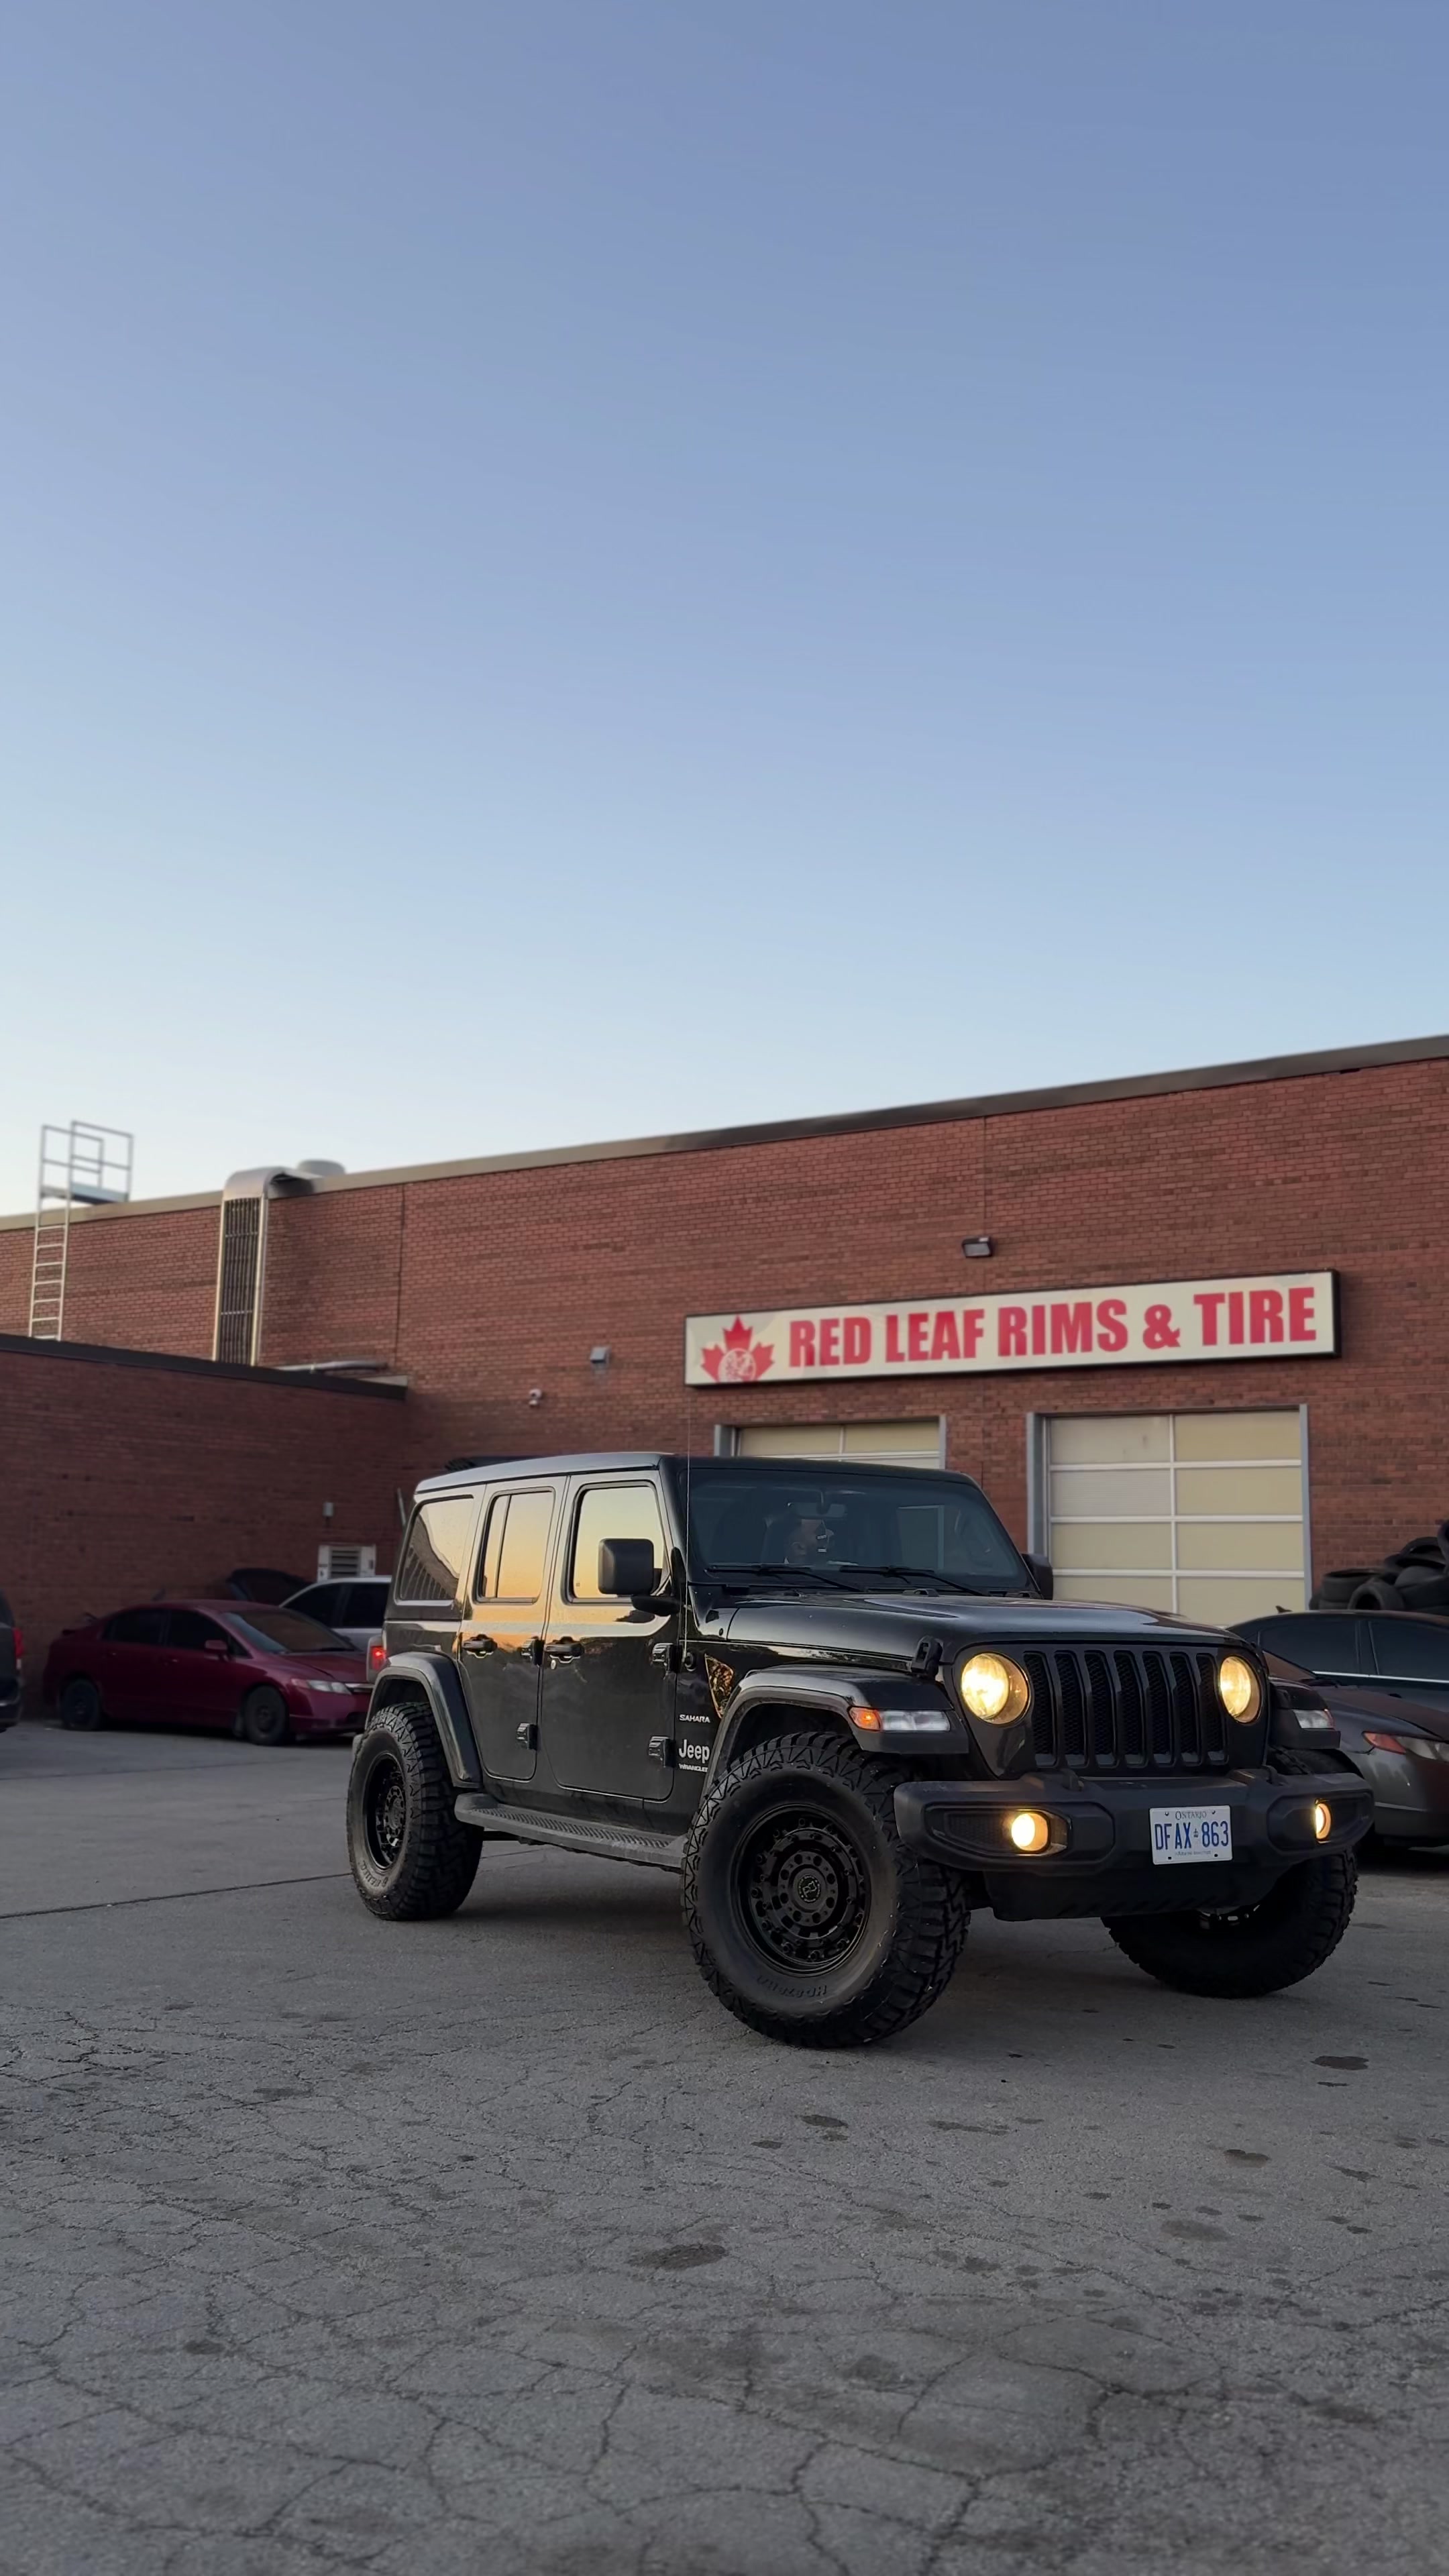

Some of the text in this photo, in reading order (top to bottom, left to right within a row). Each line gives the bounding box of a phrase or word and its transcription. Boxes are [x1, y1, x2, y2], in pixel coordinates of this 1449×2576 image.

[789, 1287, 1316, 1368] RED LEAF RIMS & TIRE
[679, 1714, 710, 1723] SAHARA
[678, 1739, 710, 1764] Jeep
